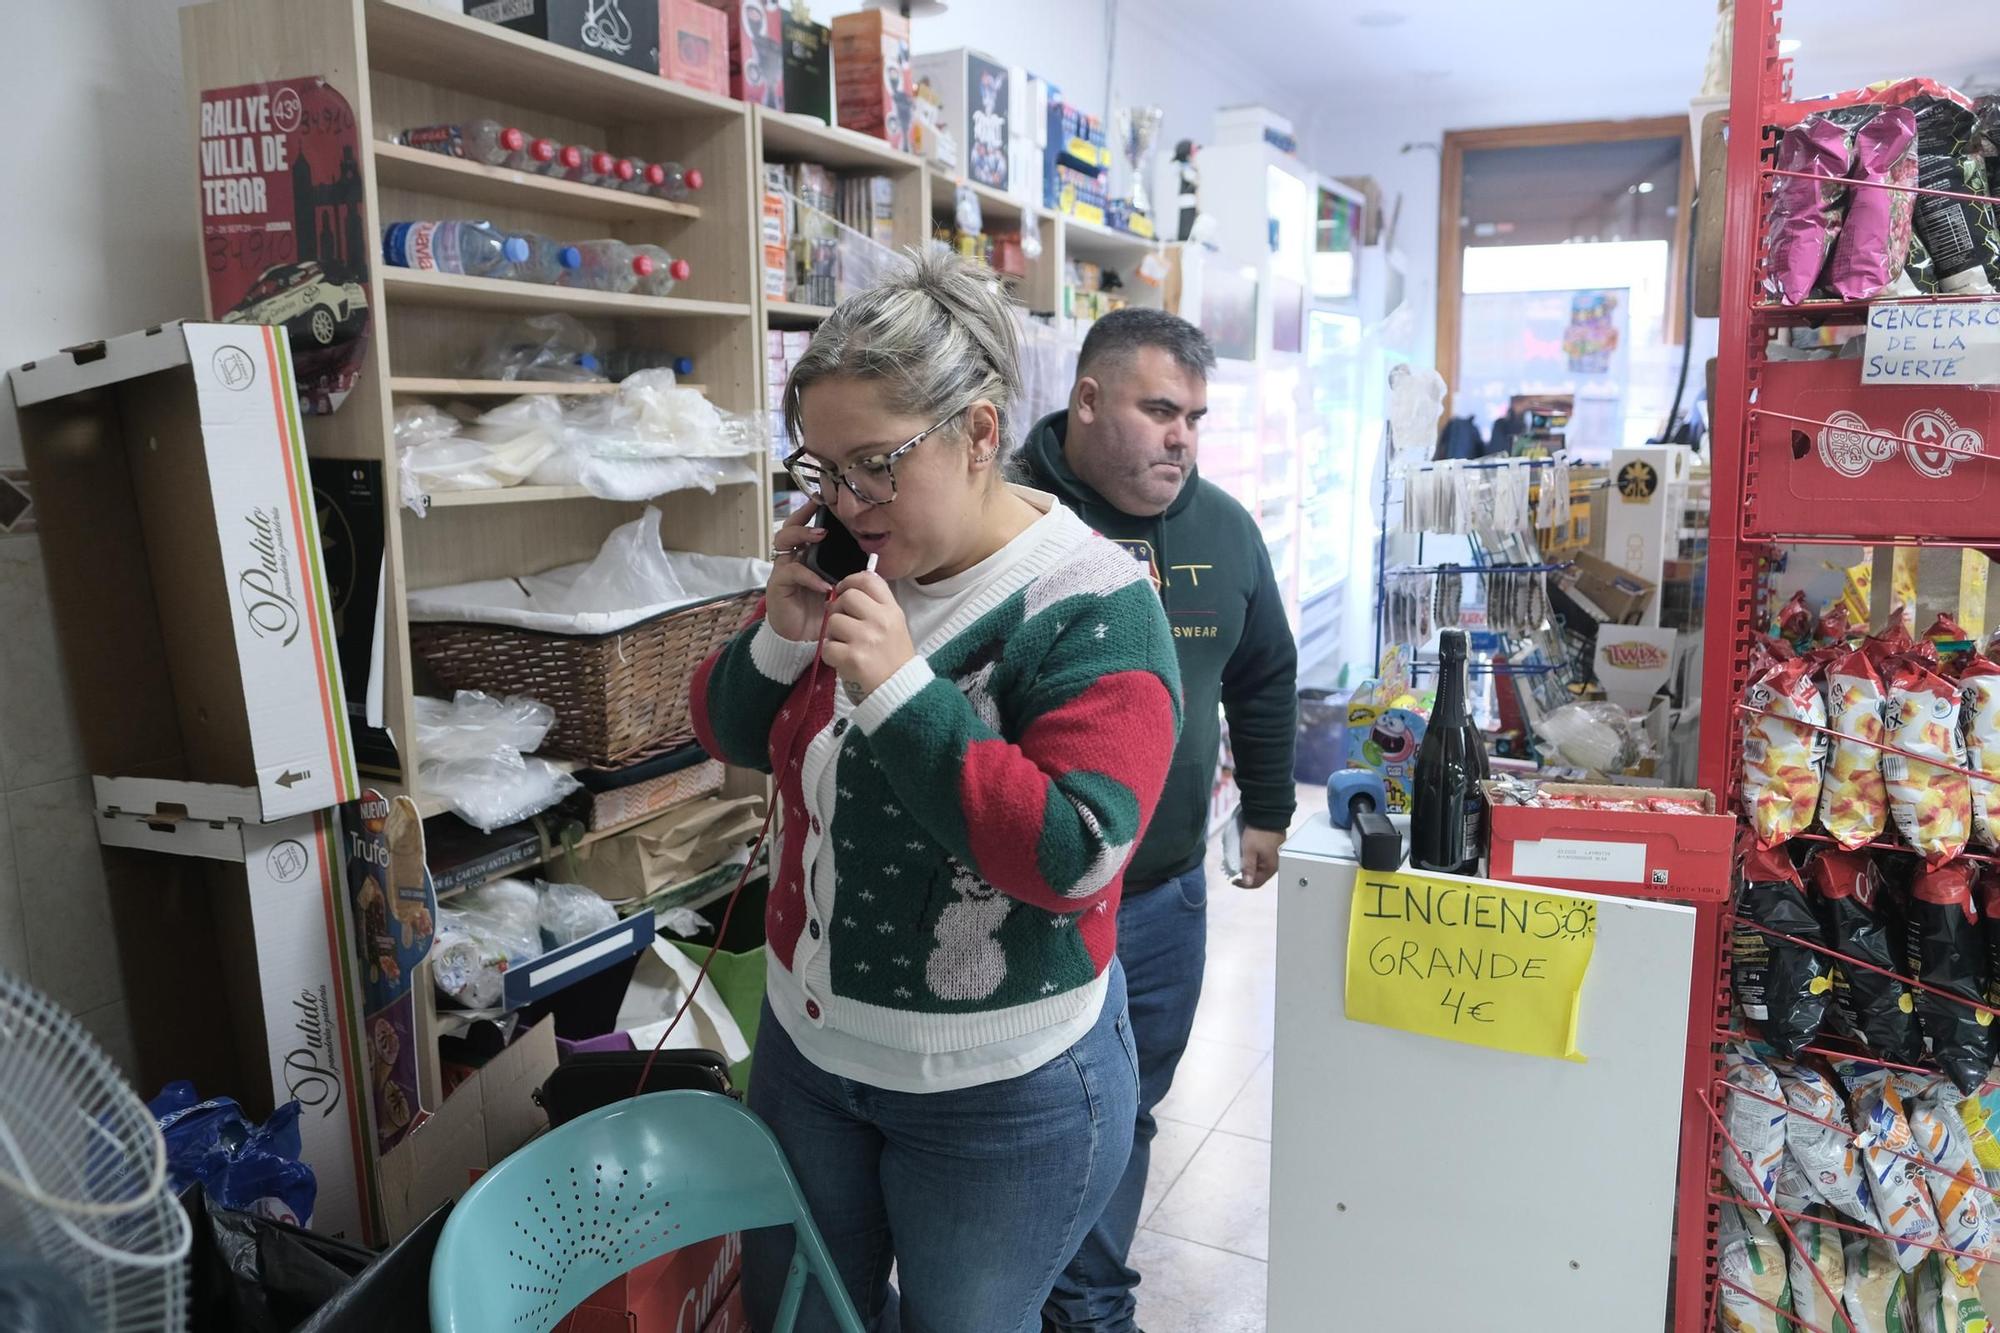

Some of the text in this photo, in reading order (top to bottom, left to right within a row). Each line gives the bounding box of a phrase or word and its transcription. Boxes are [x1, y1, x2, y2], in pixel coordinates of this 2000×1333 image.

[202, 95, 272, 137] RALLYE
[202, 134, 288, 176] VILLA DE
[203, 177, 267, 215] TEROR
[1887, 336, 1966, 351] DE LA
[1867, 356, 1966, 378] SUERTE
[1934, 407, 1960, 432] BUGLES
[239, 506, 299, 647] Pulido
[1173, 626, 1218, 638] SWEAR
[360, 800, 386, 819] NUEVO
[1364, 882, 1594, 939] INCIENSO
[1368, 935, 1548, 980] GRANDE
[1440, 987, 1496, 1024] 4€
[284, 989, 340, 1118] Pulido
